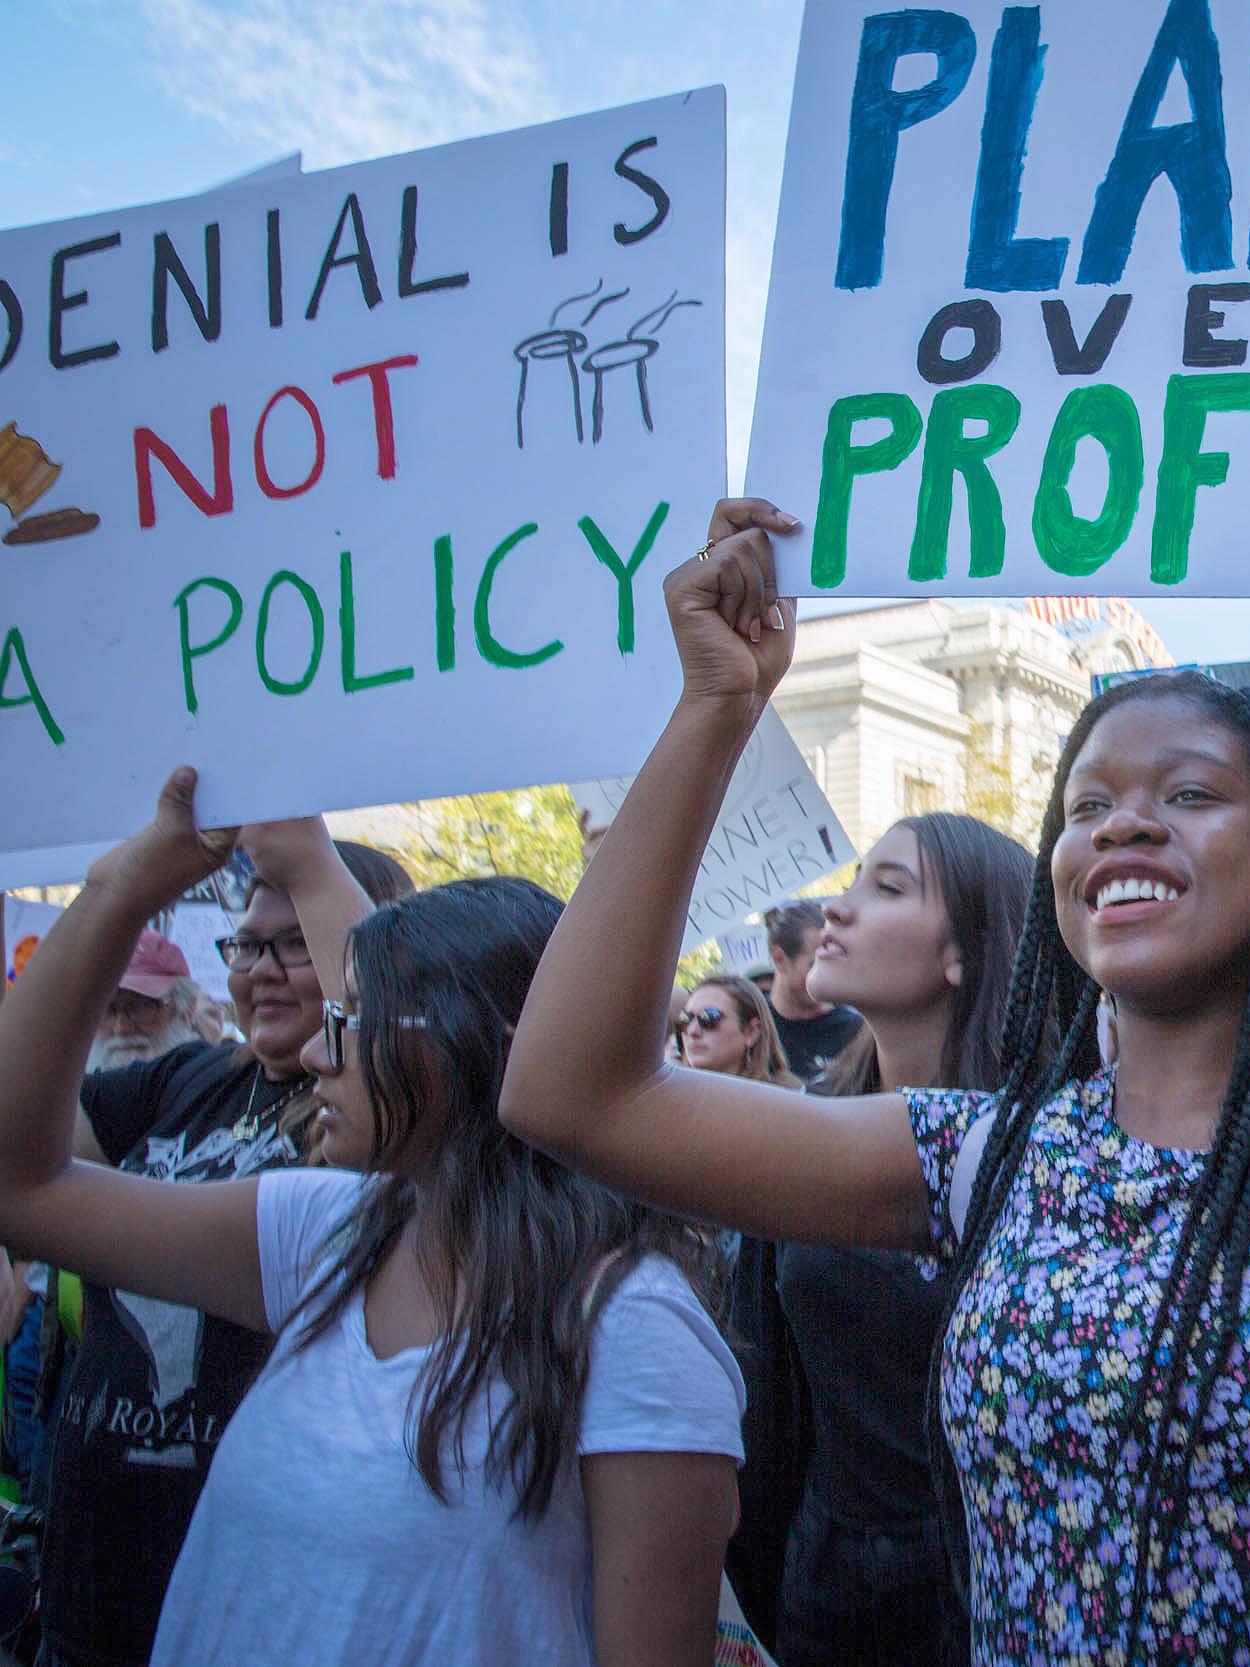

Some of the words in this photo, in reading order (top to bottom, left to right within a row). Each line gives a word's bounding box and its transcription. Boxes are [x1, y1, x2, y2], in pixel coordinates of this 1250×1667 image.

[549, 136, 670, 257] IS
[133, 354, 419, 530] NOT
[174, 500, 670, 716] POLICY
[686, 823, 836, 935] POWER!
